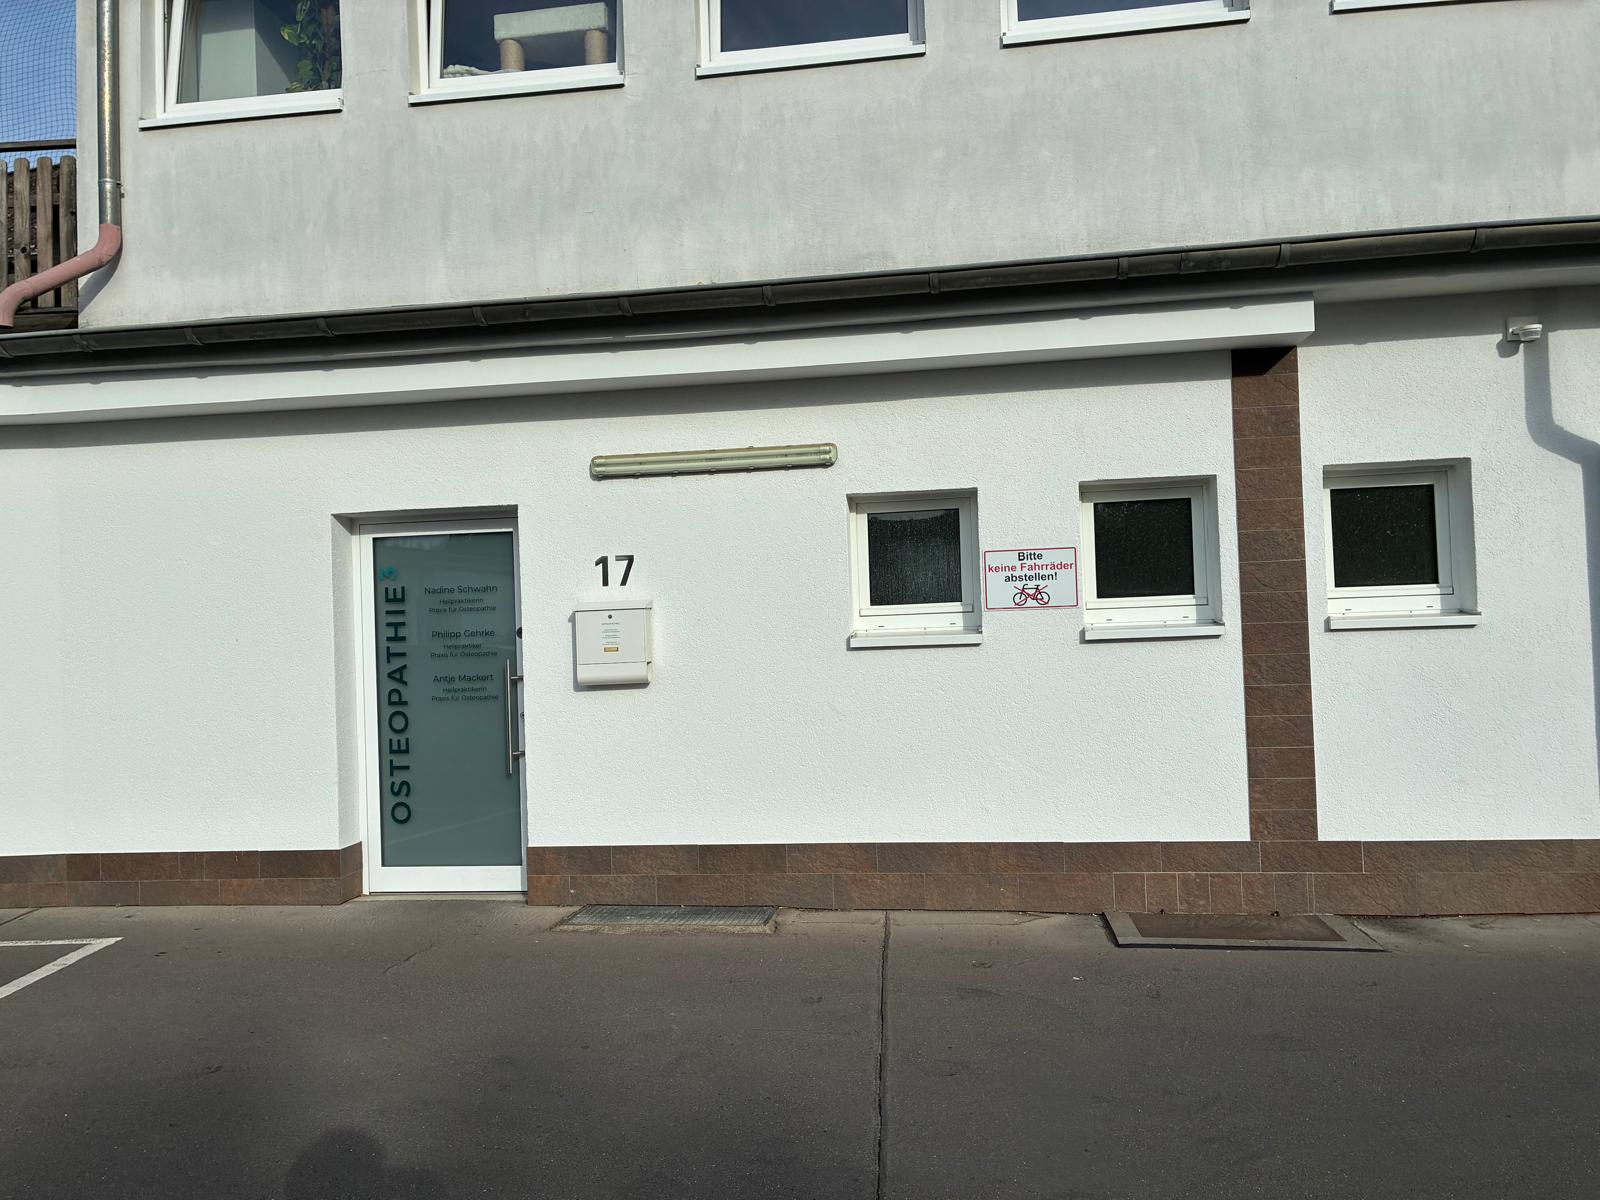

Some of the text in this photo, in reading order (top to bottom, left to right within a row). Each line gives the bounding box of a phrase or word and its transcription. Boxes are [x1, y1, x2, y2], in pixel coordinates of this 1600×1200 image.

[1017, 551, 1043, 561] Bitte
[594, 554, 635, 587] 17
[987, 561, 1074, 573] keine Fahrräder
[1004, 571, 1058, 583] abstellen!
[424, 584, 498, 595] Nadine Schwahn
[431, 629, 496, 640] Philipp Gehrke
[432, 673, 495, 684] Antje Mackert
[384, 584, 412, 825] OSTEOPATHIE
